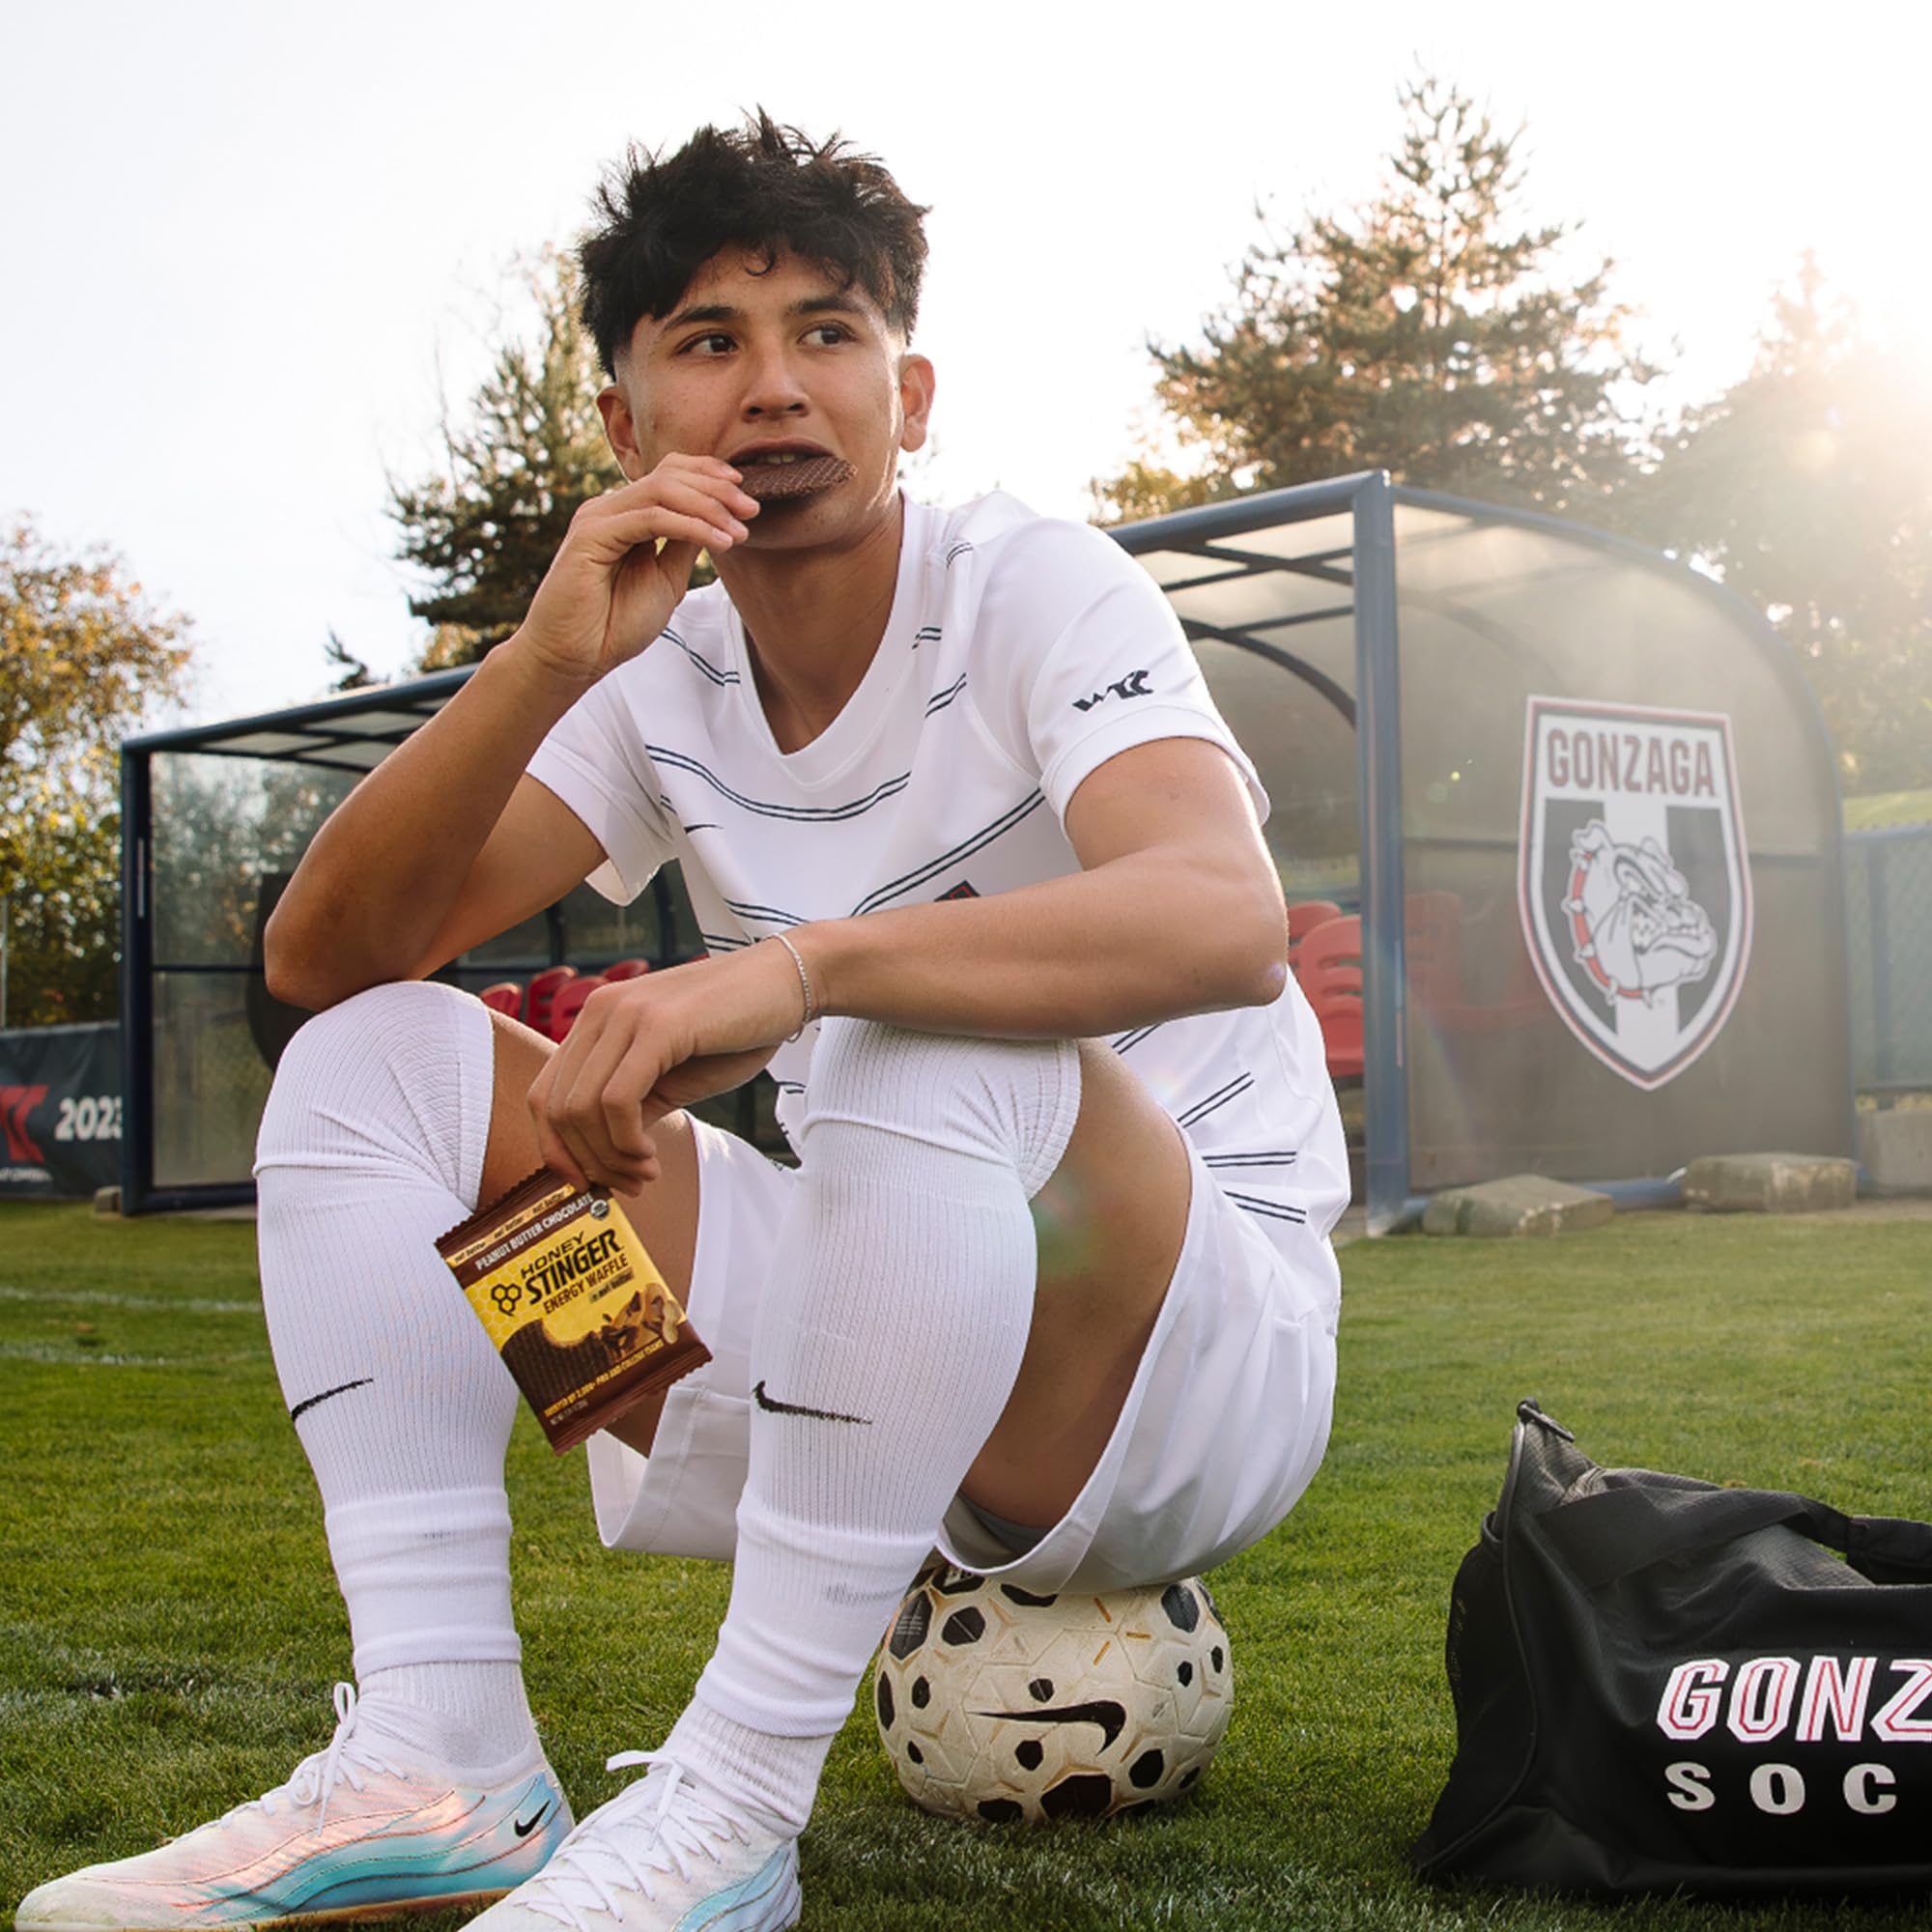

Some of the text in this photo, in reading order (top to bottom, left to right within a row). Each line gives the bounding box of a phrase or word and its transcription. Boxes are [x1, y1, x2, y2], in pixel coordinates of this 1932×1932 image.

[1548, 728, 1716, 798] GONZAGA
[474, 1243, 512, 1271] PEANUT
[509, 1223, 544, 1250] BUTTER
[542, 1192, 594, 1229] CHOCOLATE
[521, 1230, 584, 1279] HONEY
[526, 1228, 621, 1306] STINGER
[543, 1253, 629, 1315] ENERGY WAFFLE
[1656, 1655, 1932, 1744] GONZ
[1664, 1761, 1897, 1815] SOC
